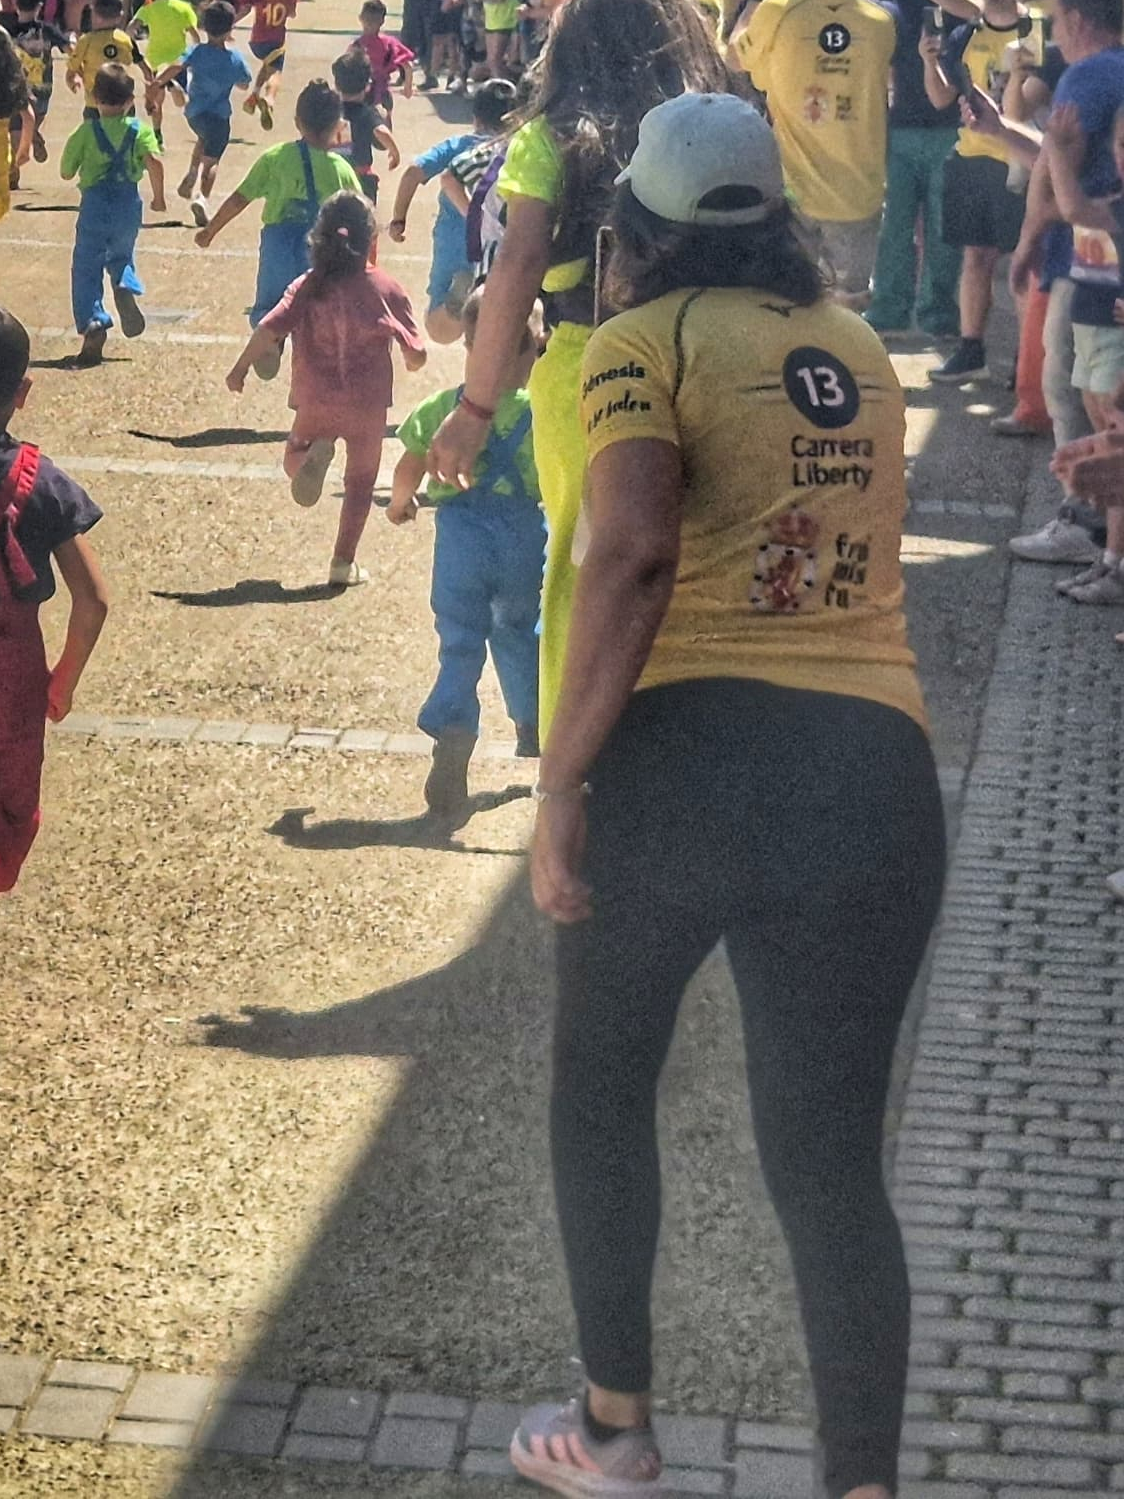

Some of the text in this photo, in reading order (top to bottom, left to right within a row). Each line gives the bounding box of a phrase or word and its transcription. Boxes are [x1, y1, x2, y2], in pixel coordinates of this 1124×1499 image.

[262, 2, 286, 28] 10
[826, 30, 844, 47] 13
[796, 366, 846, 408] 13
[791, 435, 874, 459] Carrera
[792, 463, 873, 492] Liberty
